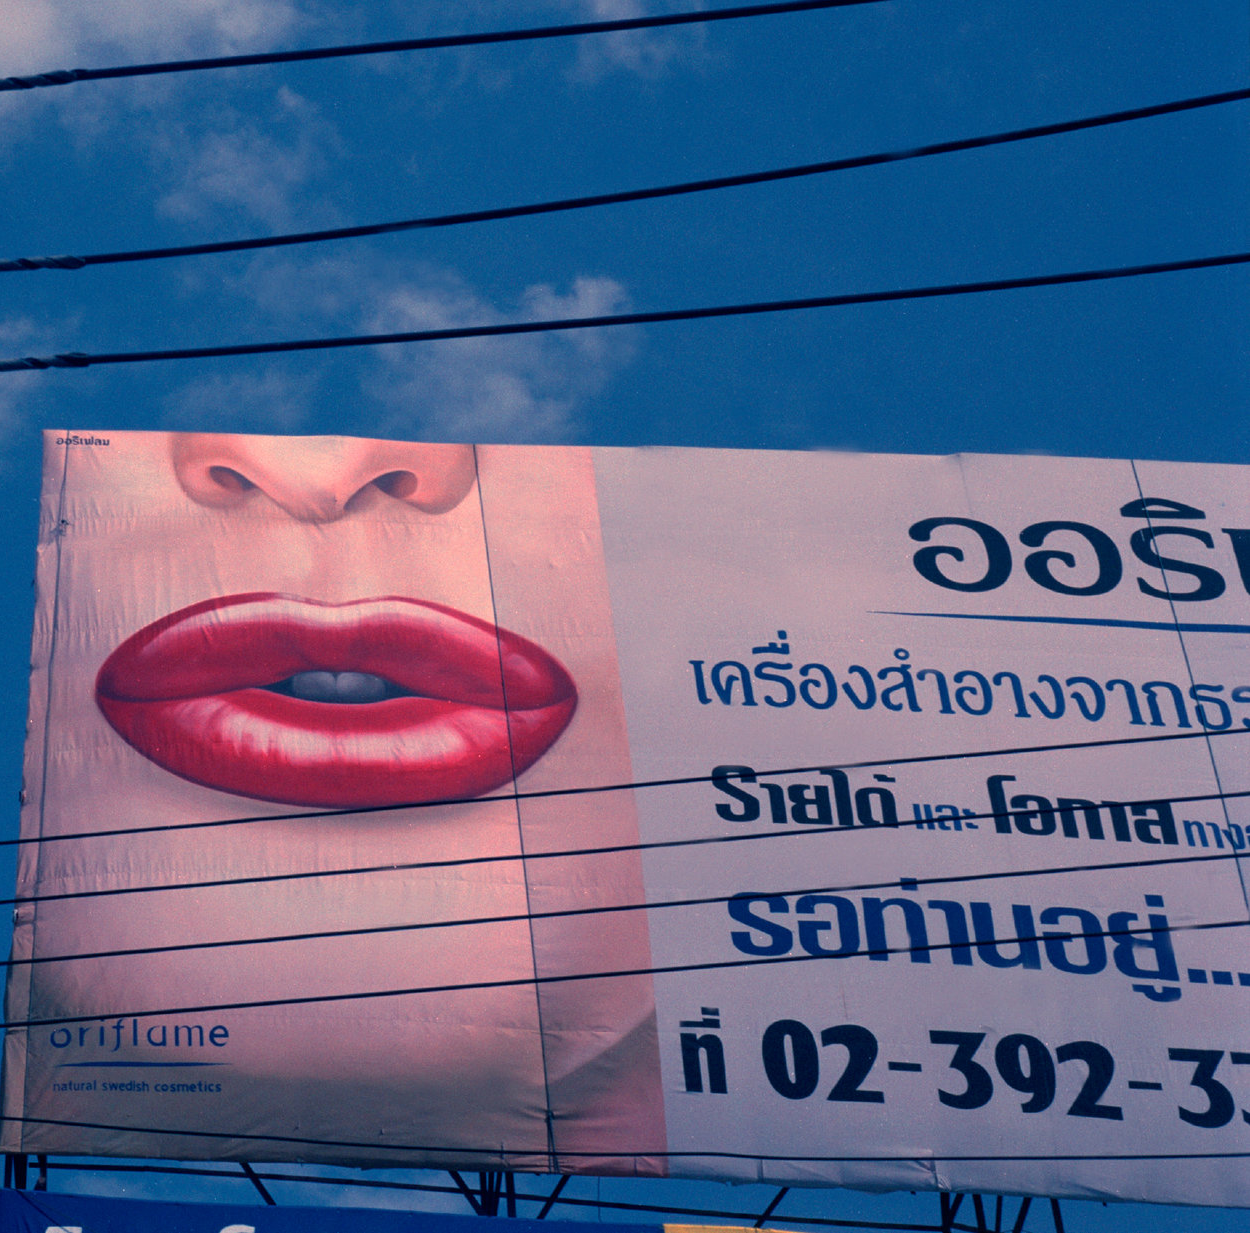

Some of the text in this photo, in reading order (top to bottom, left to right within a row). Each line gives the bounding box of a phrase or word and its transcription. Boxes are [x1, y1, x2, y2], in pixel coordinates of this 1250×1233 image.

[711, 764, 1250, 851] รายได้ และ โอกาส ทาง
[50, 1017, 230, 1052] oriflame
[679, 1007, 728, 1094] ที่
[53, 1079, 222, 1093] natural swedish cosmetics
